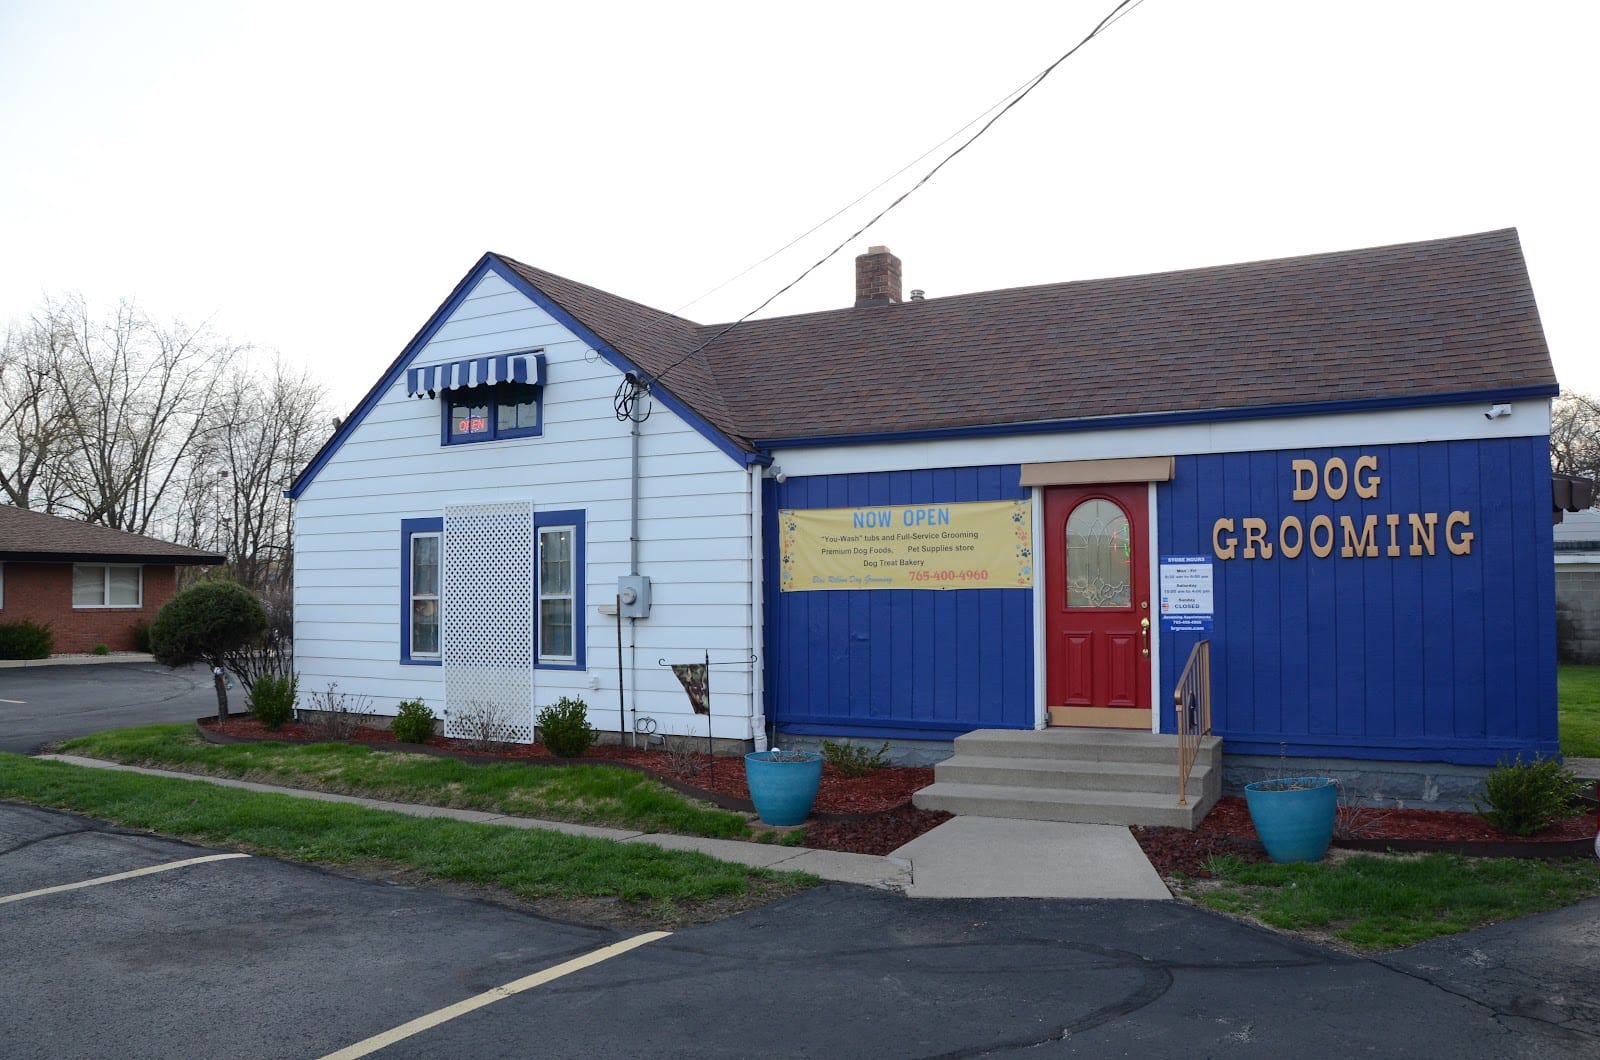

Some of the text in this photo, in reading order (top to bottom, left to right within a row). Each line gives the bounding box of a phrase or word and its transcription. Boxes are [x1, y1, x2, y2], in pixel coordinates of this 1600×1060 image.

[459, 418, 485, 431] OPEN
[1292, 455, 1381, 501] DOG
[853, 507, 949, 529] NOW OPEN
[881, 533, 895, 541] and
[896, 532, 940, 540] Full-Service
[941, 531, 979, 540] Grooming
[1212, 510, 1474, 560] GROOMING
[853, 547, 868, 556] Dog
[921, 545, 953, 554] Supplies
[863, 559, 925, 568] Dog Treat Bakery
[909, 570, 989, 582] 765-400-4960
